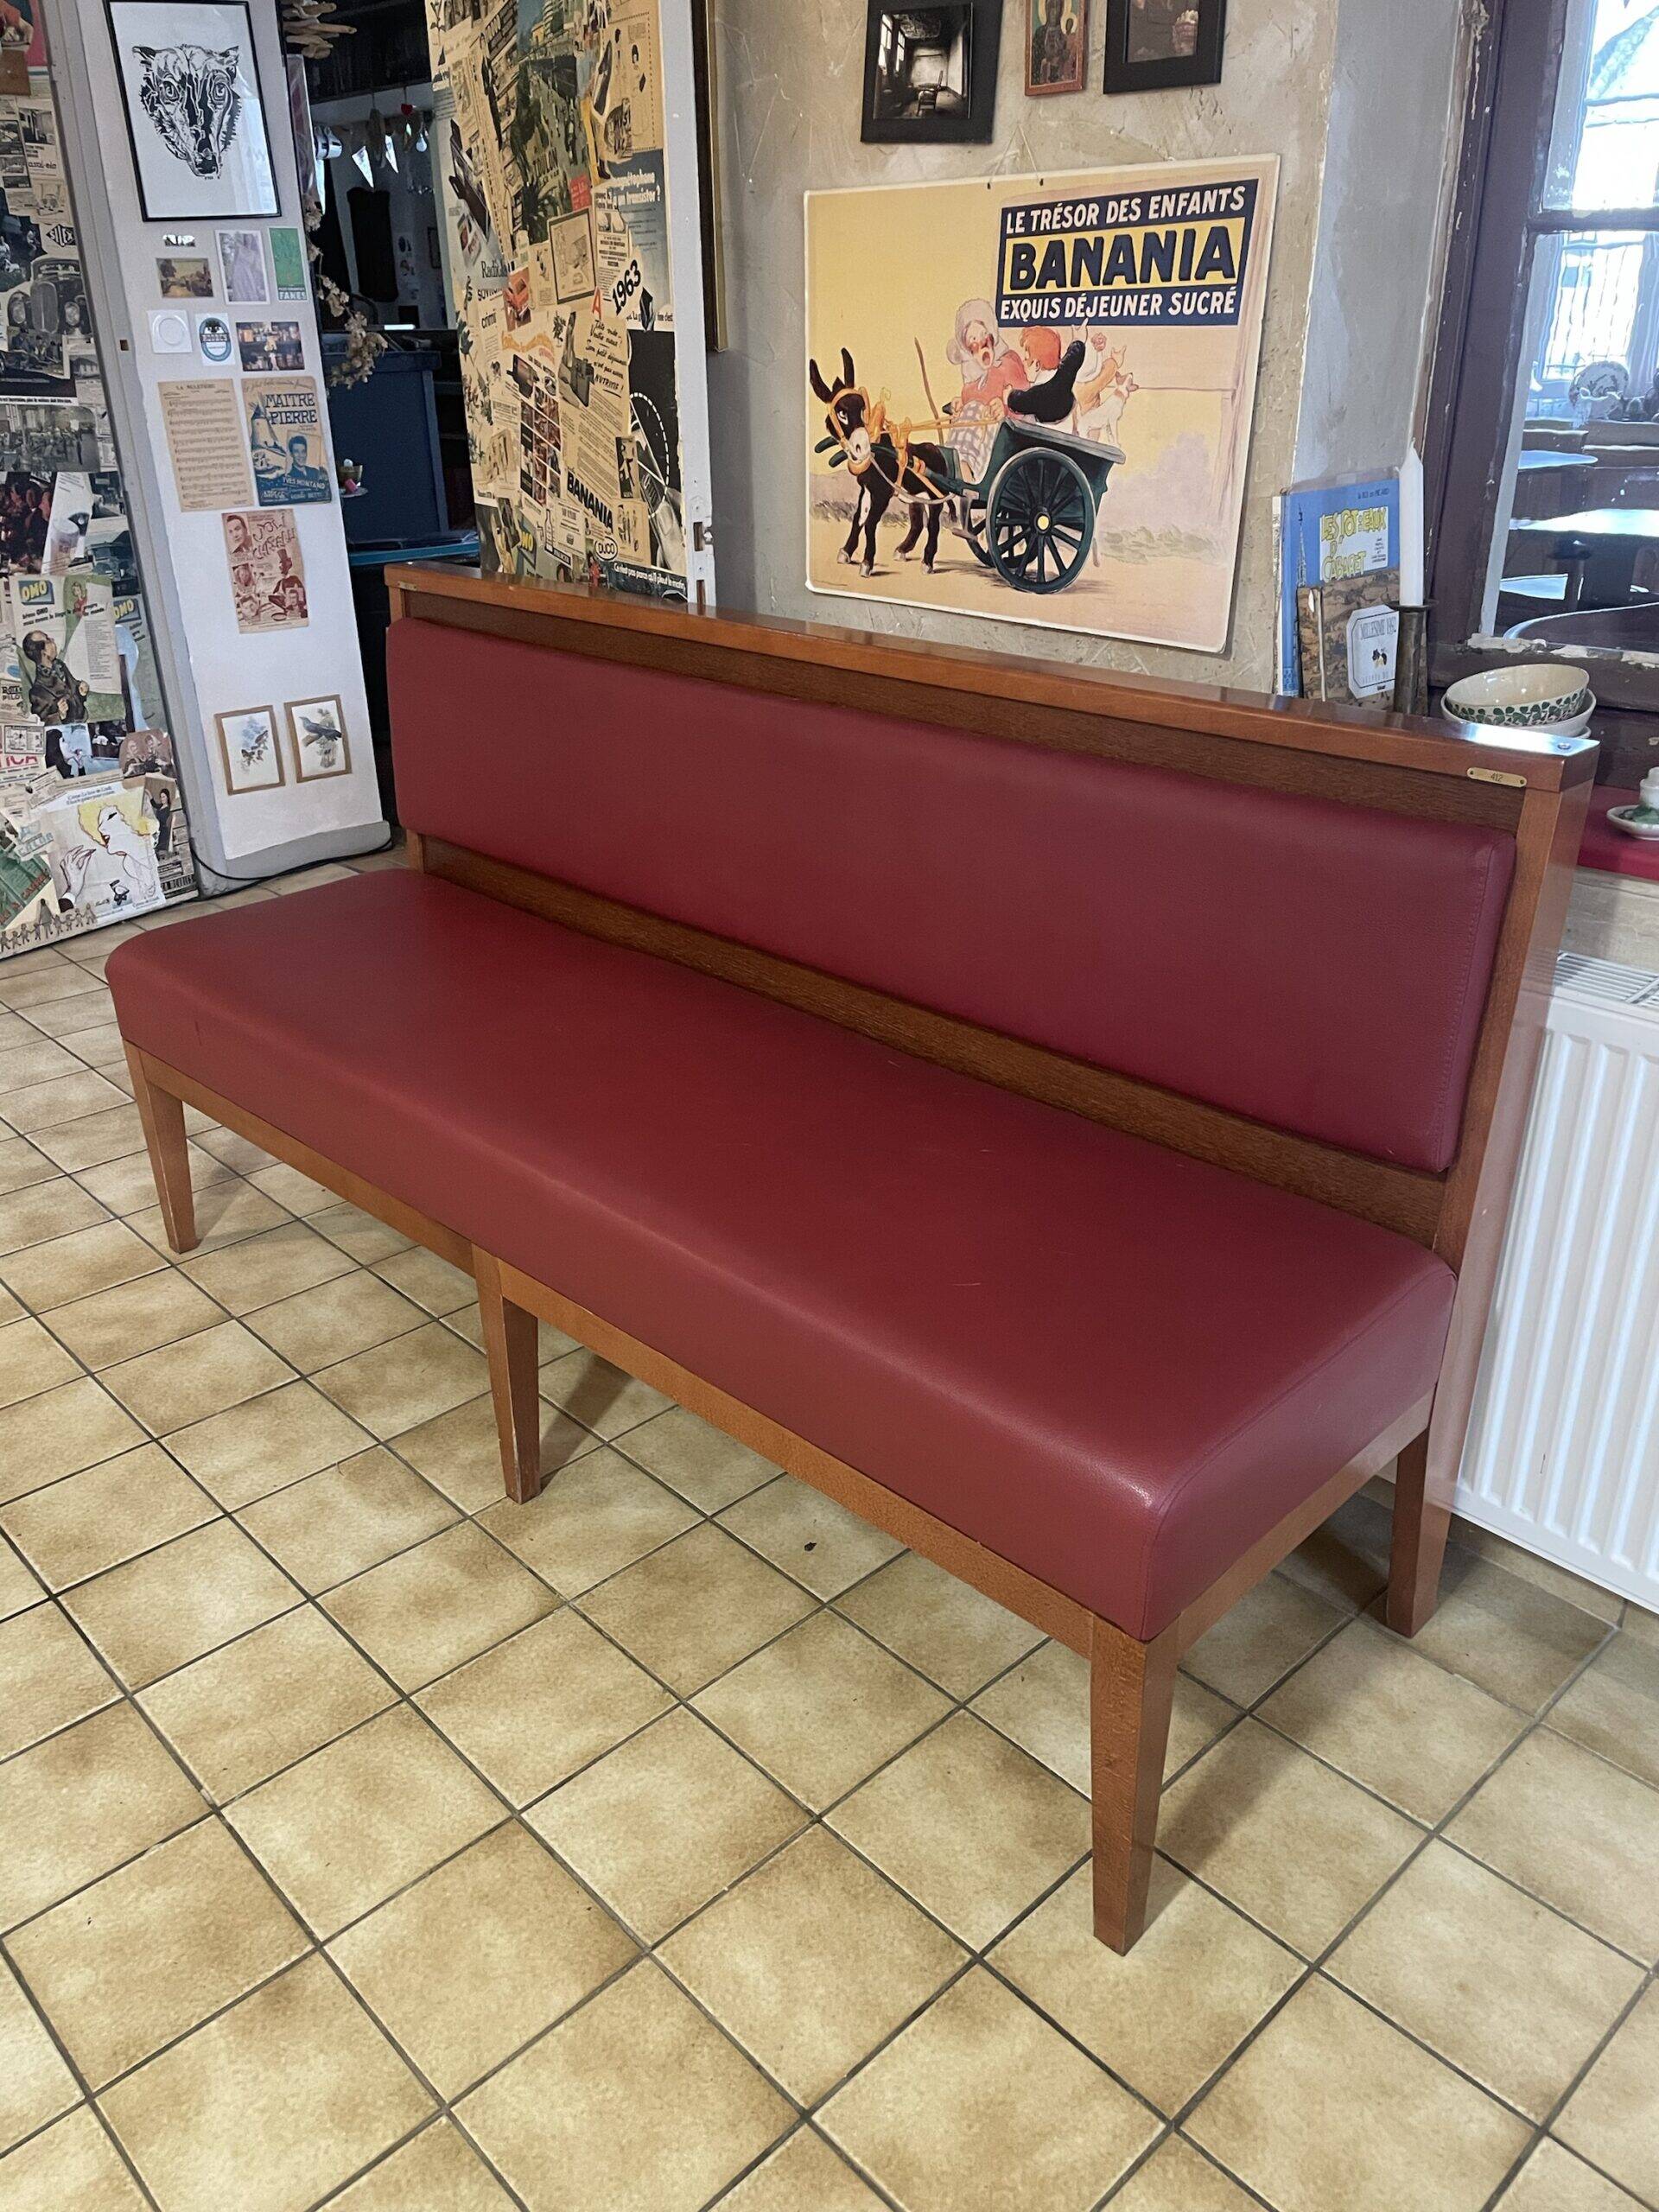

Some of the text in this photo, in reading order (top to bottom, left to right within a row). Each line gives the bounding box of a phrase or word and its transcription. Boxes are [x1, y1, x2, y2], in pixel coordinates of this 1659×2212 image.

[1006, 185, 1246, 234] LE TRÉSOR DES ENFANTS
[1009, 226, 1236, 290] BANANIA
[612, 260, 641, 315] 1963
[1000, 287, 1236, 322] EXQUIS DÉJEUNER SUCRÉ
[265, 392, 315, 408] MAITRE
[270, 410, 318, 425] PIERRE
[567, 470, 613, 534] BANANIA
[252, 516, 287, 542] JOLI
[1321, 512, 1339, 542] LES
[598, 543, 615, 555] DUCO
[1322, 550, 1367, 583] CABARET
[21, 581, 48, 601] OMO
[113, 599, 134, 619] OMO
